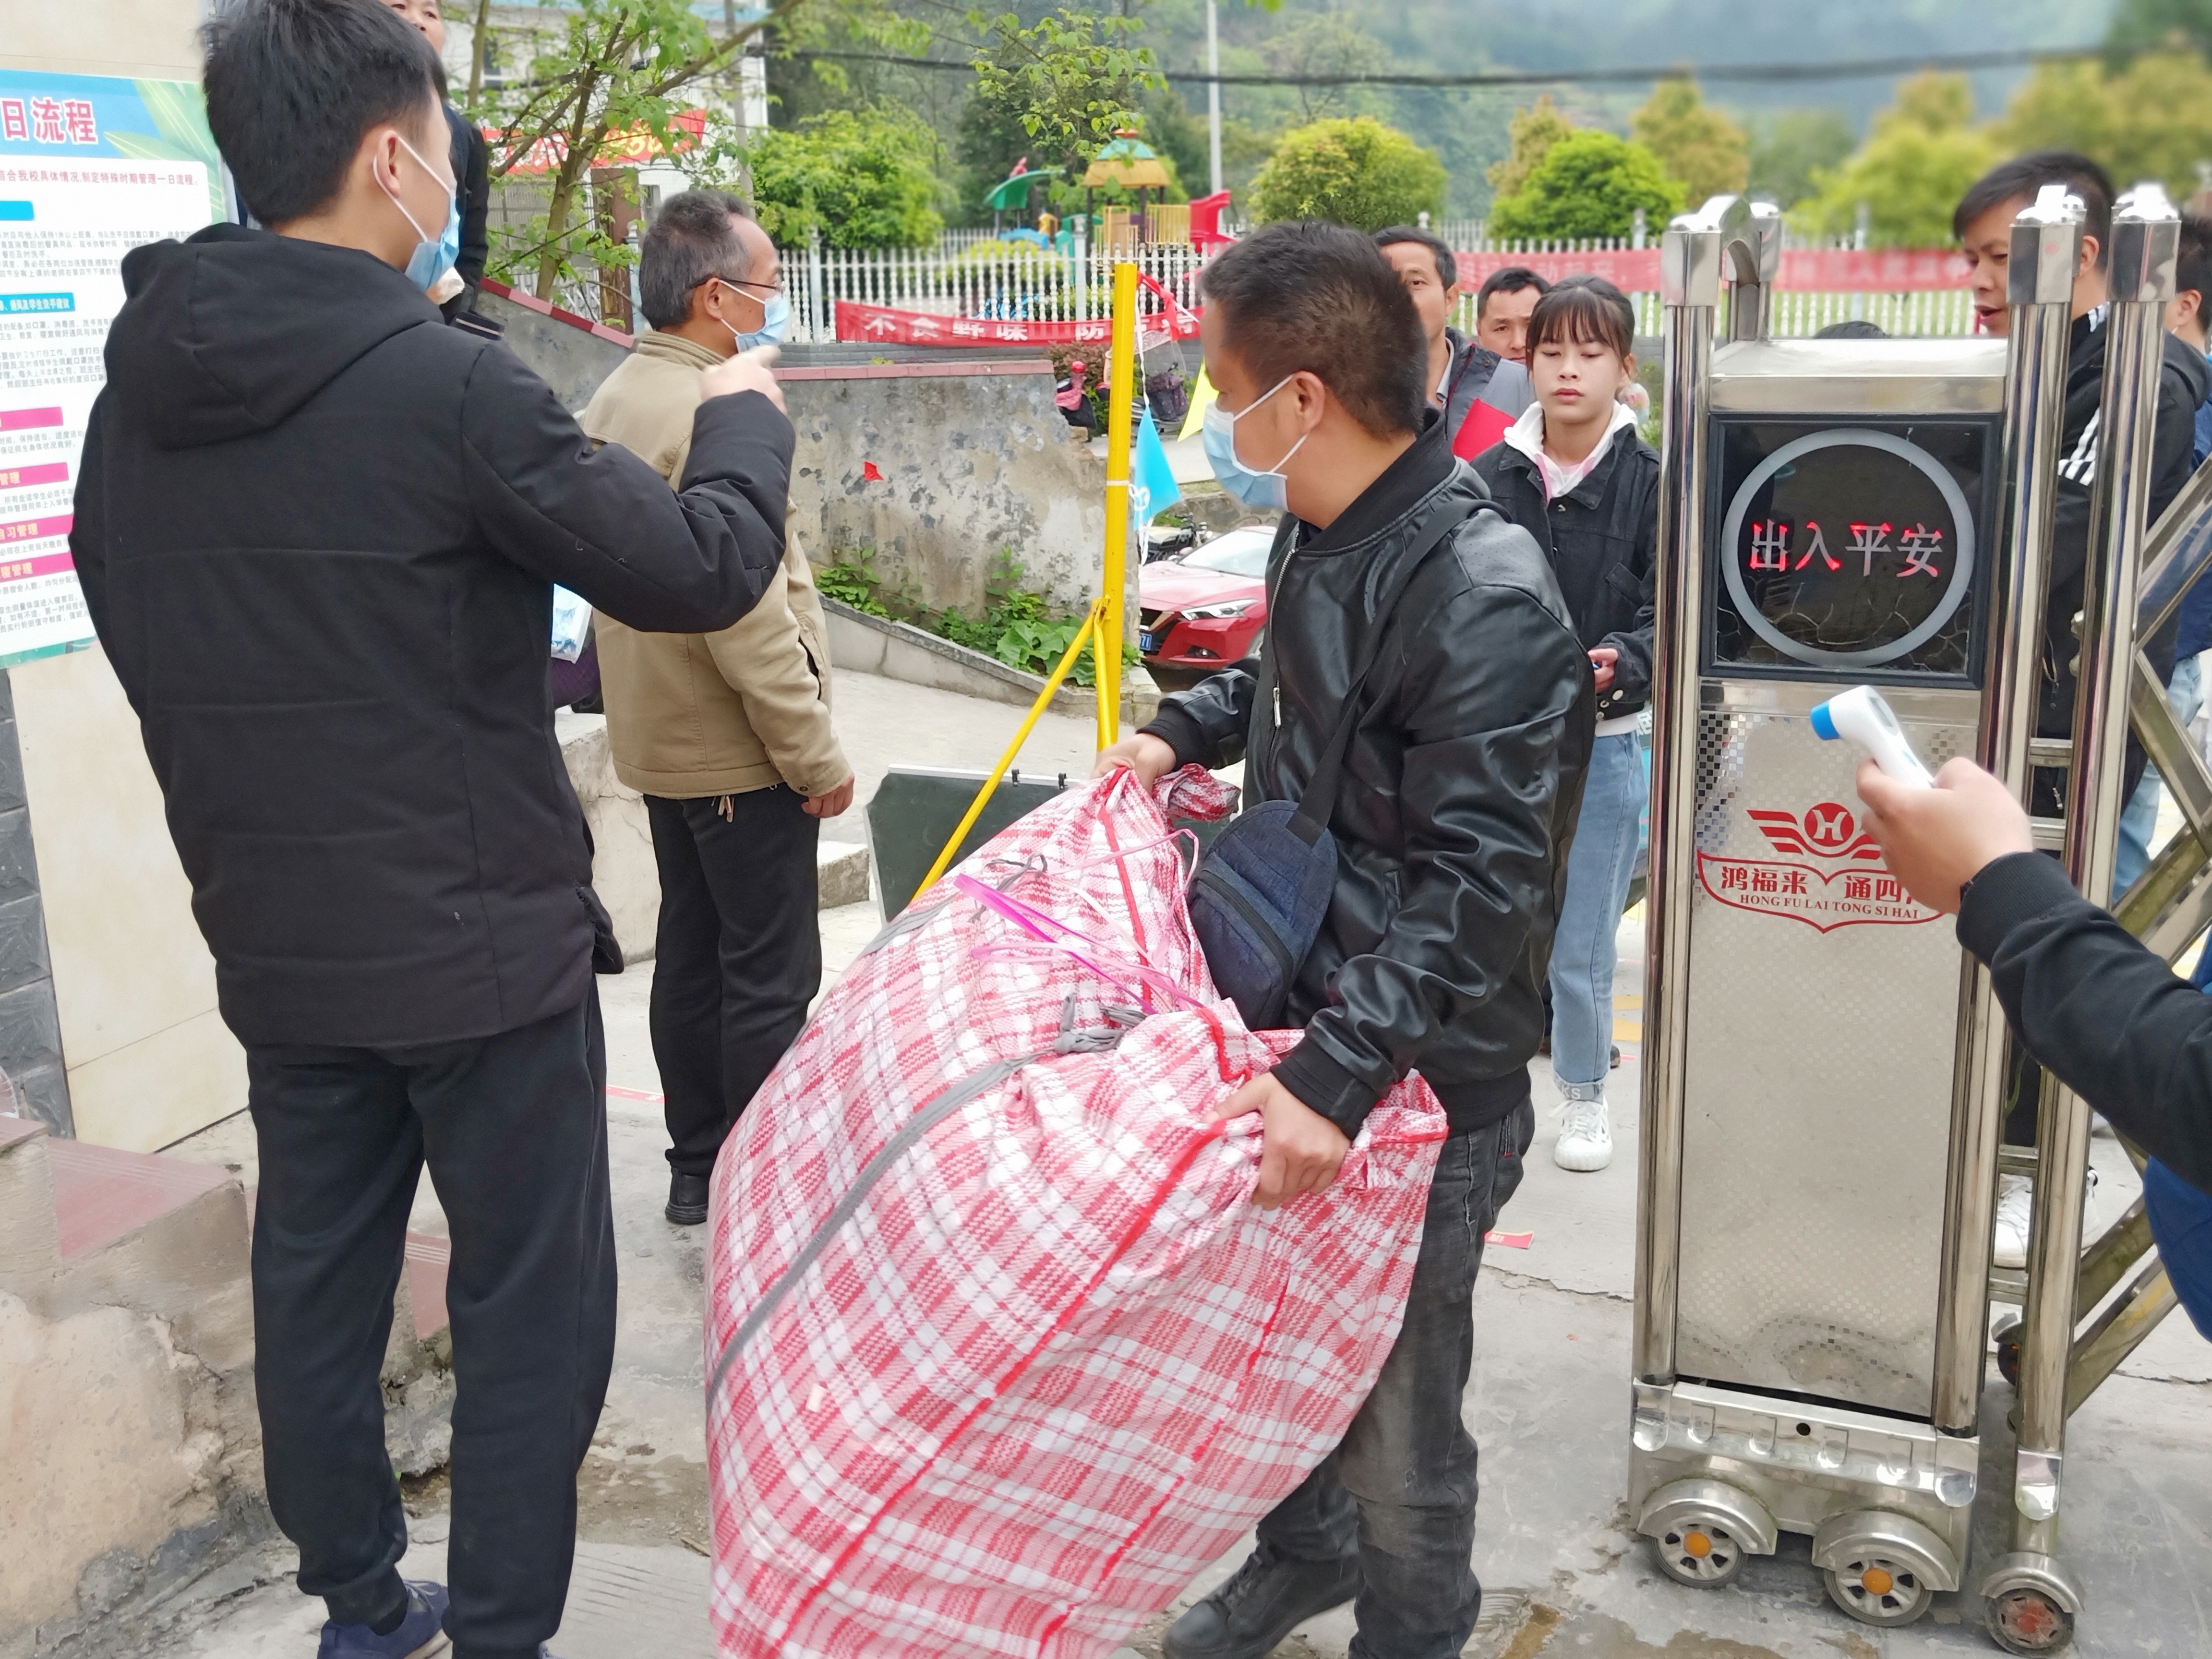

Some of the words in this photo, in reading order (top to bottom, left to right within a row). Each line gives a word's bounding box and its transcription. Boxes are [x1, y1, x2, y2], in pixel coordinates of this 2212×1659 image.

[1, 96, 98, 144] 日流程
[864, 313, 1029, 341] 不食野味
[1749, 518, 1943, 577] 出入平安
[1139, 635, 1150, 648] 71
[1721, 866, 1808, 894] 鸿福来
[1844, 875, 1912, 905] 通四
[1740, 894, 1780, 906] HONG
[1784, 897, 1801, 908] FU
[1804, 899, 1828, 911] LAI
[1833, 902, 1871, 915] TONG
[1875, 905, 1888, 916] SI
[1892, 907, 1918, 919] HAI
